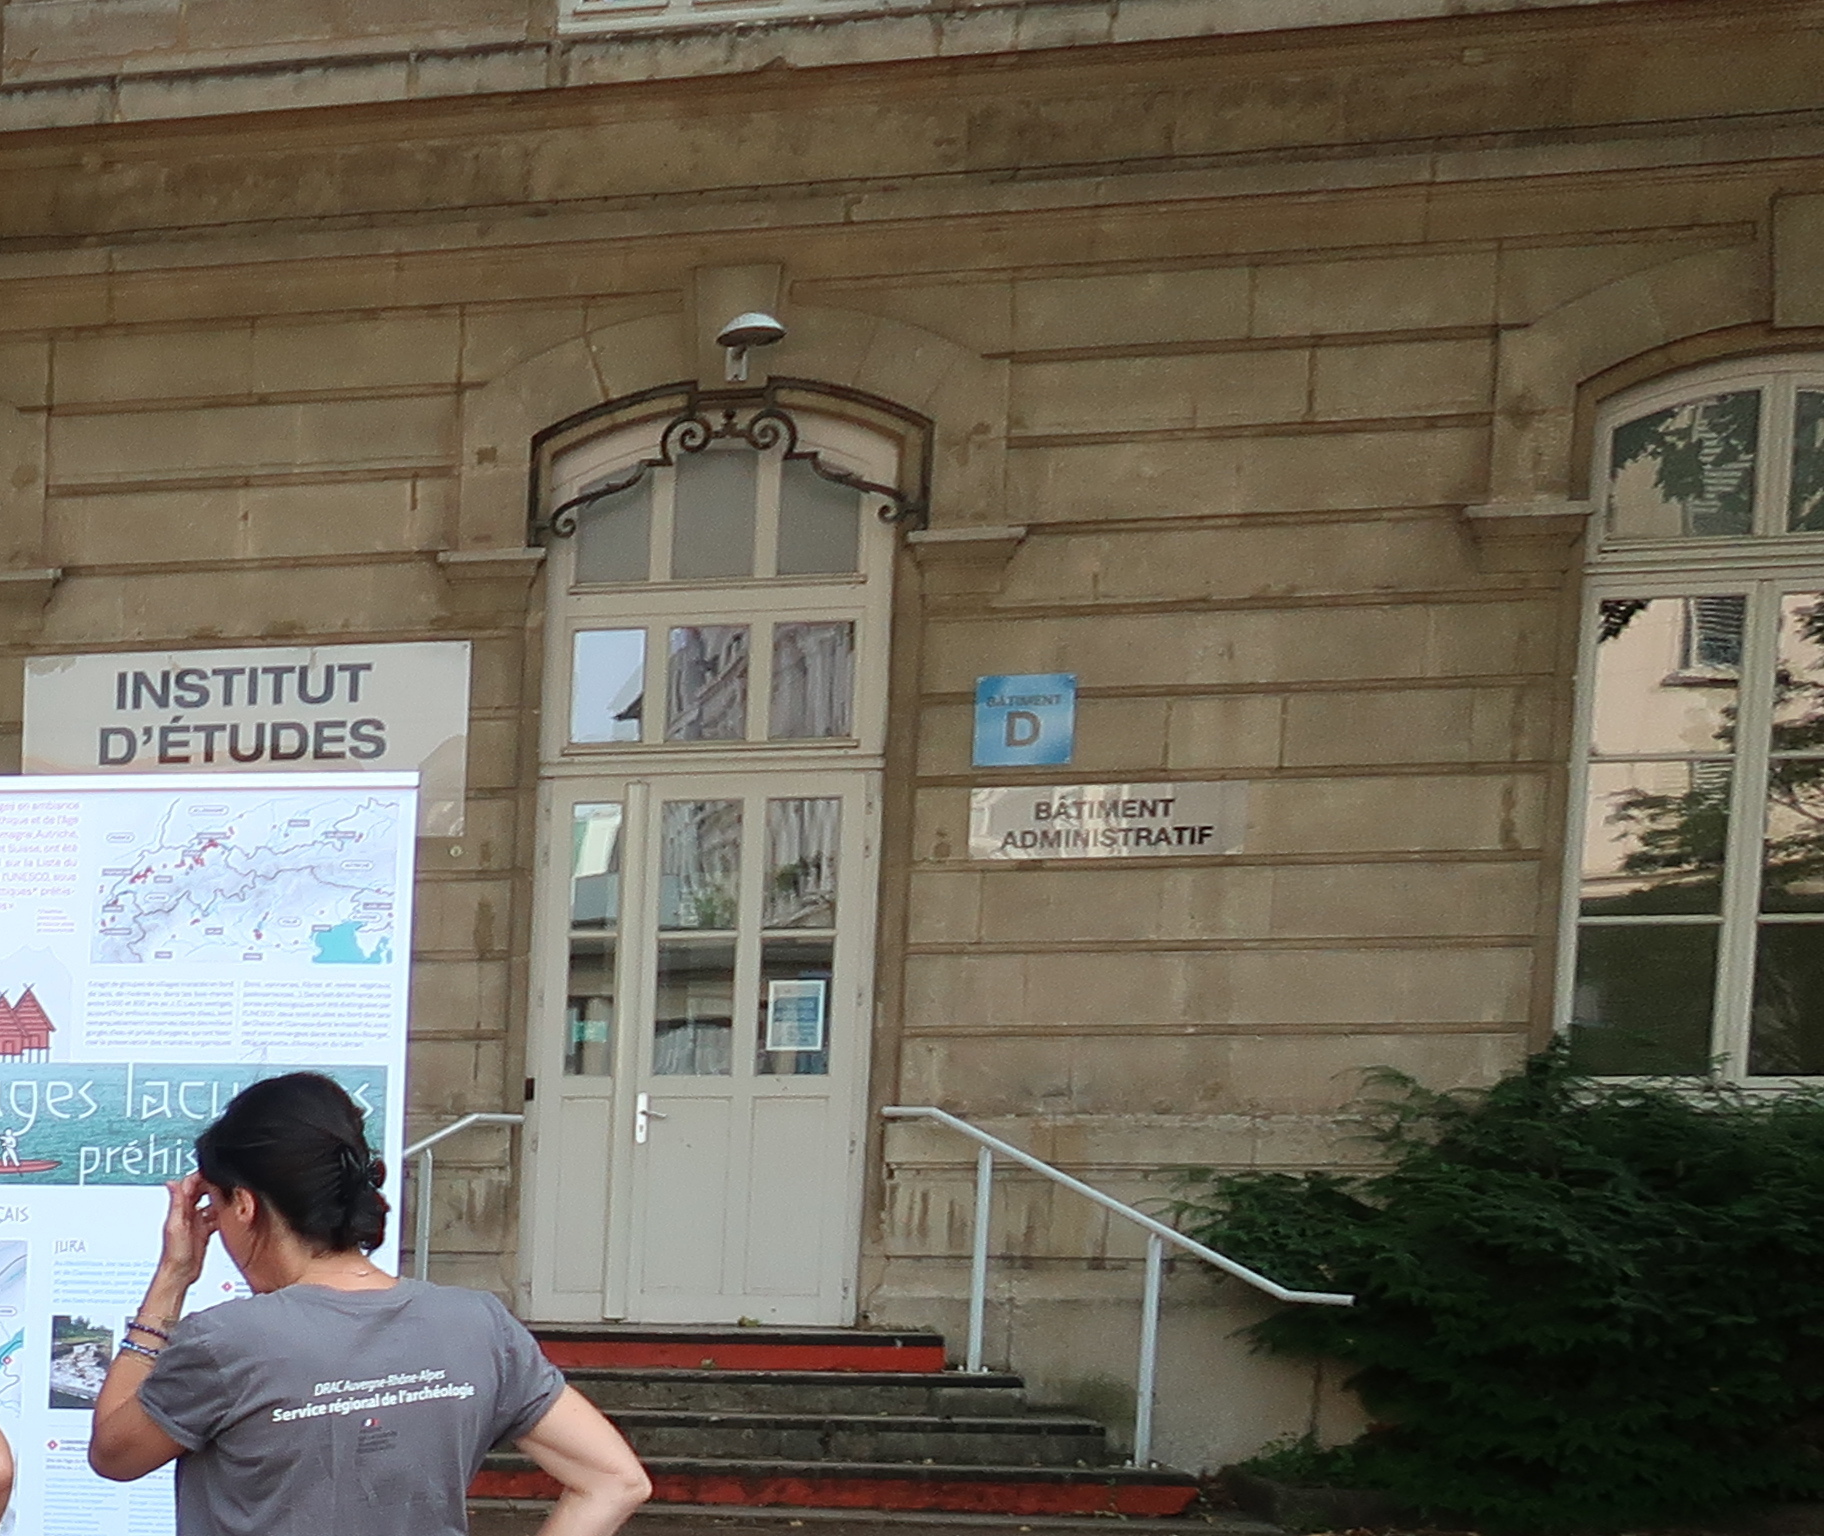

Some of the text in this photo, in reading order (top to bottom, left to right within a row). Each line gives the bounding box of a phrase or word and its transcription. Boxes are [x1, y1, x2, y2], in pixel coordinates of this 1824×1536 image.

[116, 662, 373, 711] INSTITUT
[98, 716, 387, 766] D'ÉTUDES
[1005, 711, 1041, 747] D
[1035, 796, 1176, 821] BÂTIMENT
[1002, 826, 1215, 850] ADMINISTRATIF
[53, 1239, 87, 1255] JURA
[313, 1368, 446, 1397] DRAC Auvergne-Rhône-Alpes
[272, 1382, 475, 1423] Service régional de l'archéologie
